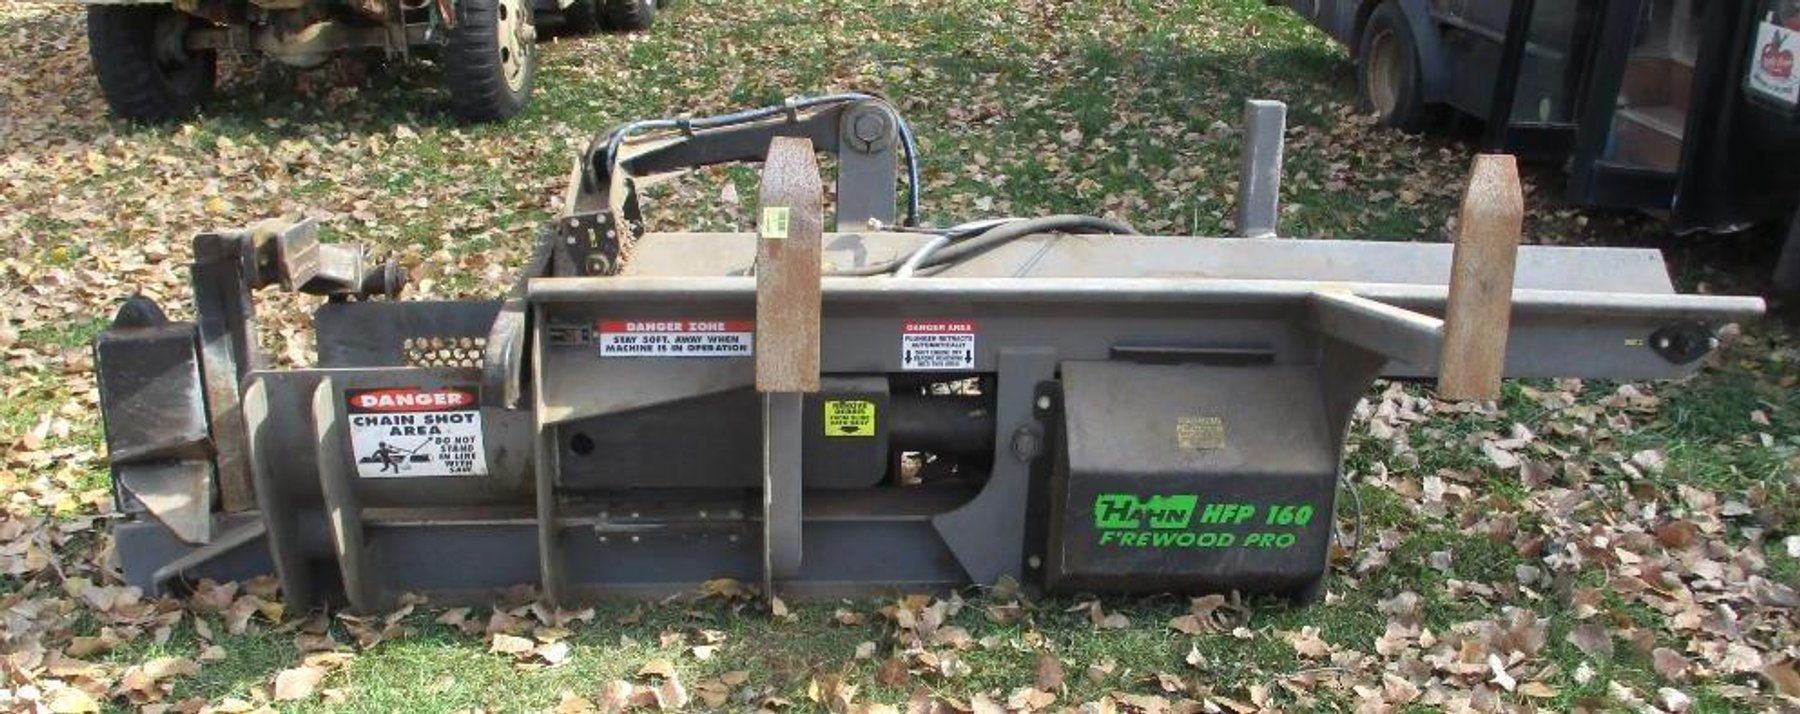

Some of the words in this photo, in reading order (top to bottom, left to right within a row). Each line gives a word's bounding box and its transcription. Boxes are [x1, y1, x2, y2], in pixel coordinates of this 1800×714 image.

[626, 321, 683, 332] DANGER
[688, 321, 726, 332] ZONE
[613, 335, 638, 344] STAY
[674, 335, 702, 344] AWAY
[707, 335, 740, 344] WHEN
[605, 344, 654, 352] MACHINE
[657, 344, 667, 352] IS
[672, 344, 683, 352] IN
[687, 344, 748, 352] OPERATION
[361, 393, 463, 408] DANGER
[353, 414, 415, 427] CHAIN
[423, 413, 475, 425] SHOT
[389, 425, 442, 436] AREA
[435, 436, 451, 445] DO
[455, 436, 476, 444] NOT
[440, 444, 475, 452] STAND
[444, 460, 473, 468] WITH
[1199, 503, 1255, 524] HFP
[1265, 504, 1315, 526] 160
[1243, 532, 1297, 549] PRO
